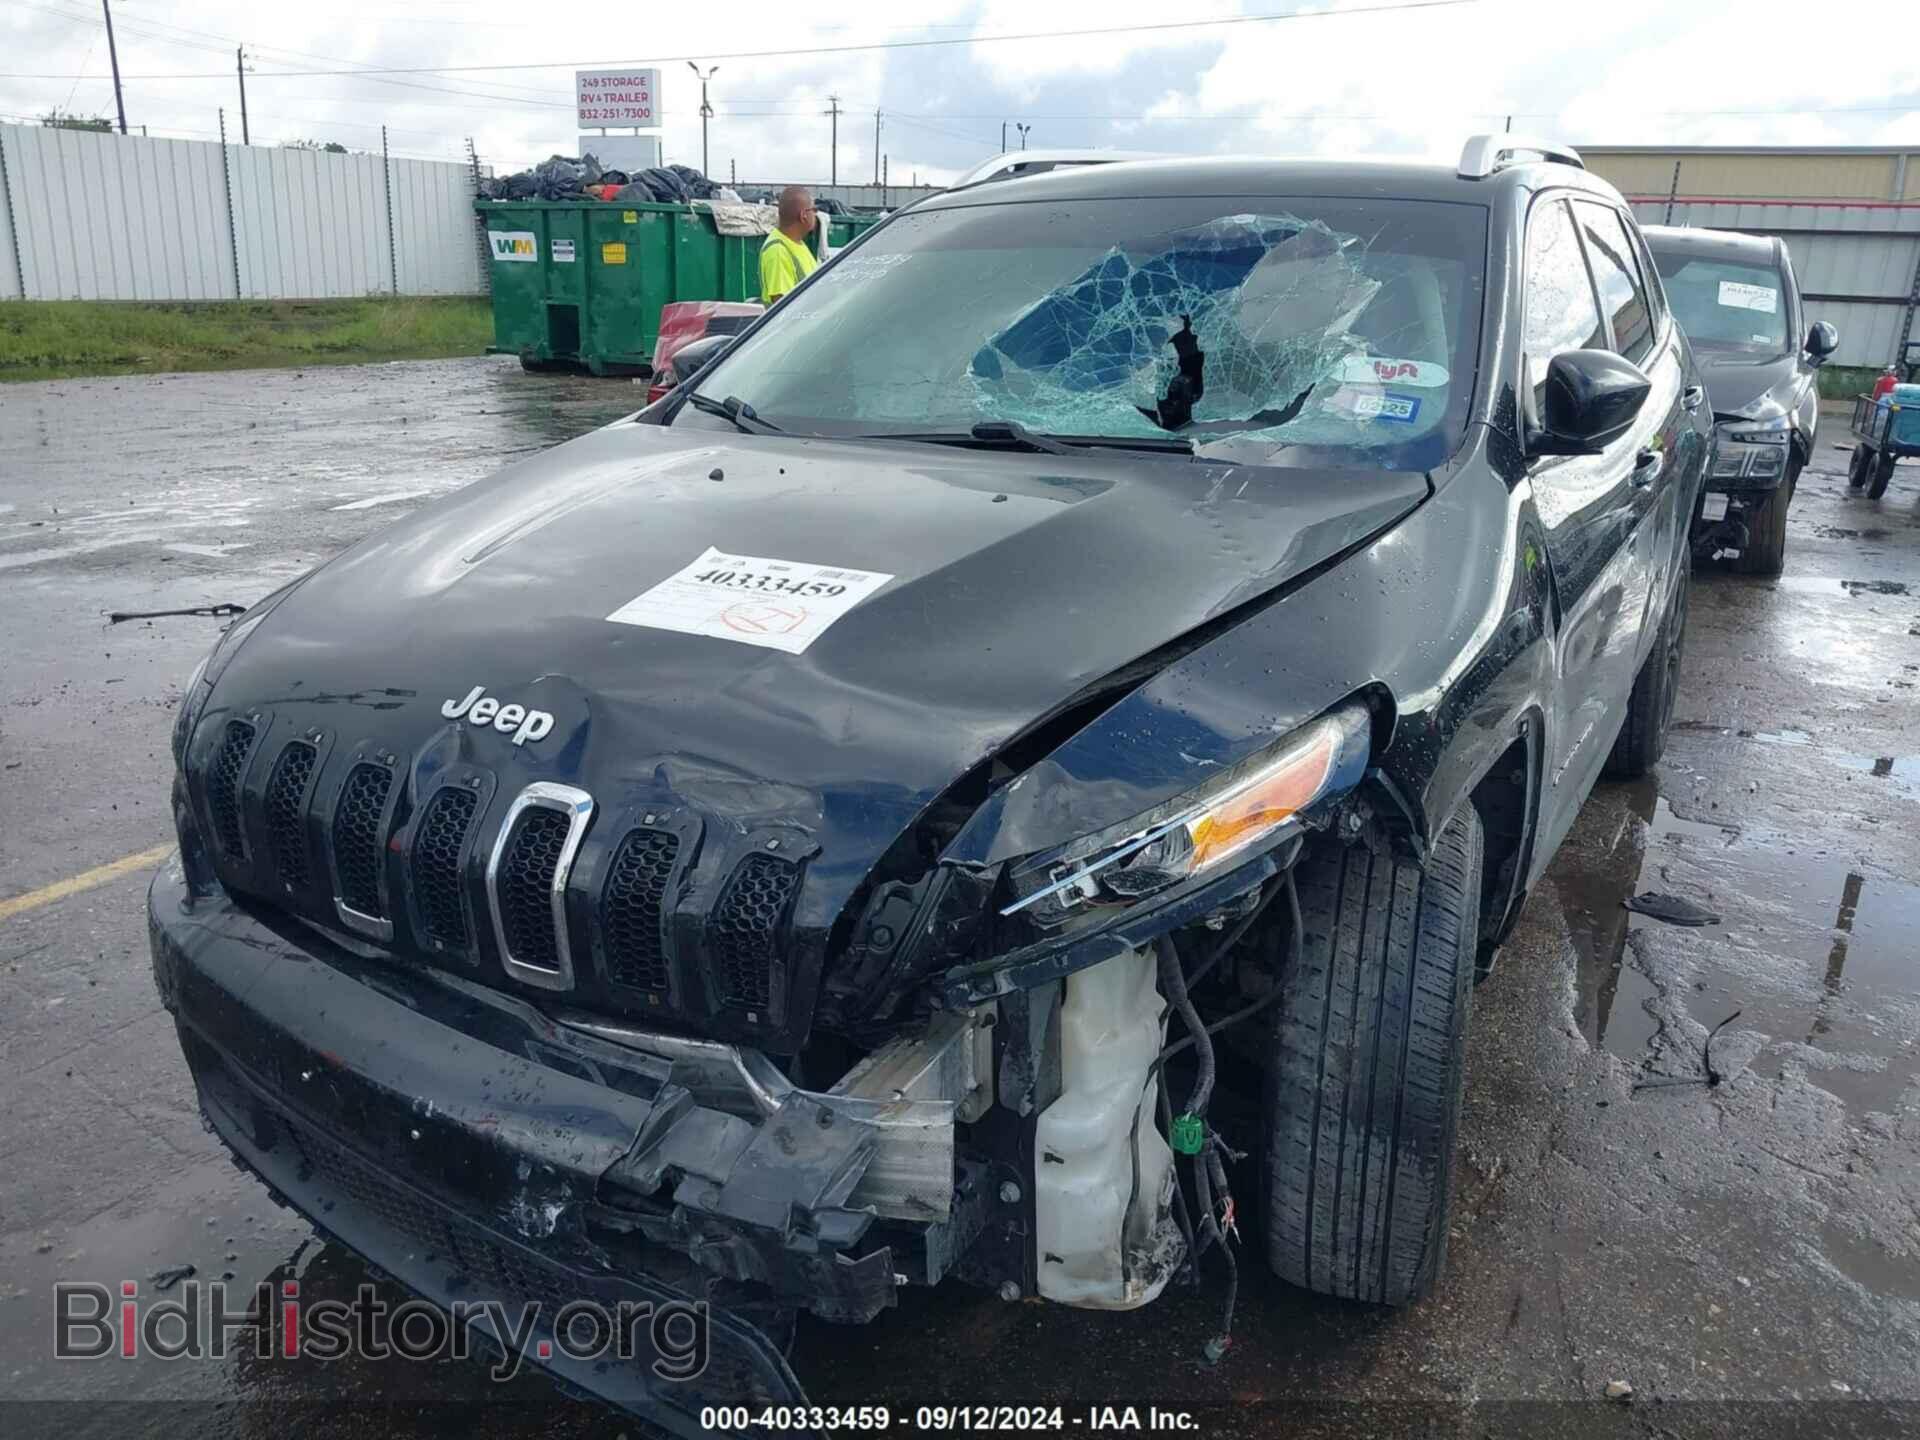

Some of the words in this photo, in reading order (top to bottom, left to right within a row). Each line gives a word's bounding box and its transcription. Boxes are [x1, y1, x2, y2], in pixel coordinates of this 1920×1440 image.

[581, 78, 599, 88] 249
[601, 76, 647, 88] STORAGE
[580, 93, 595, 104] RV
[603, 92, 648, 103] TRAILER
[579, 108, 650, 119] 832-251-7300
[496, 239, 534, 256] WM
[1374, 360, 1417, 379] lyft
[694, 569, 847, 598] 40333459
[440, 685, 554, 746] Jeep
